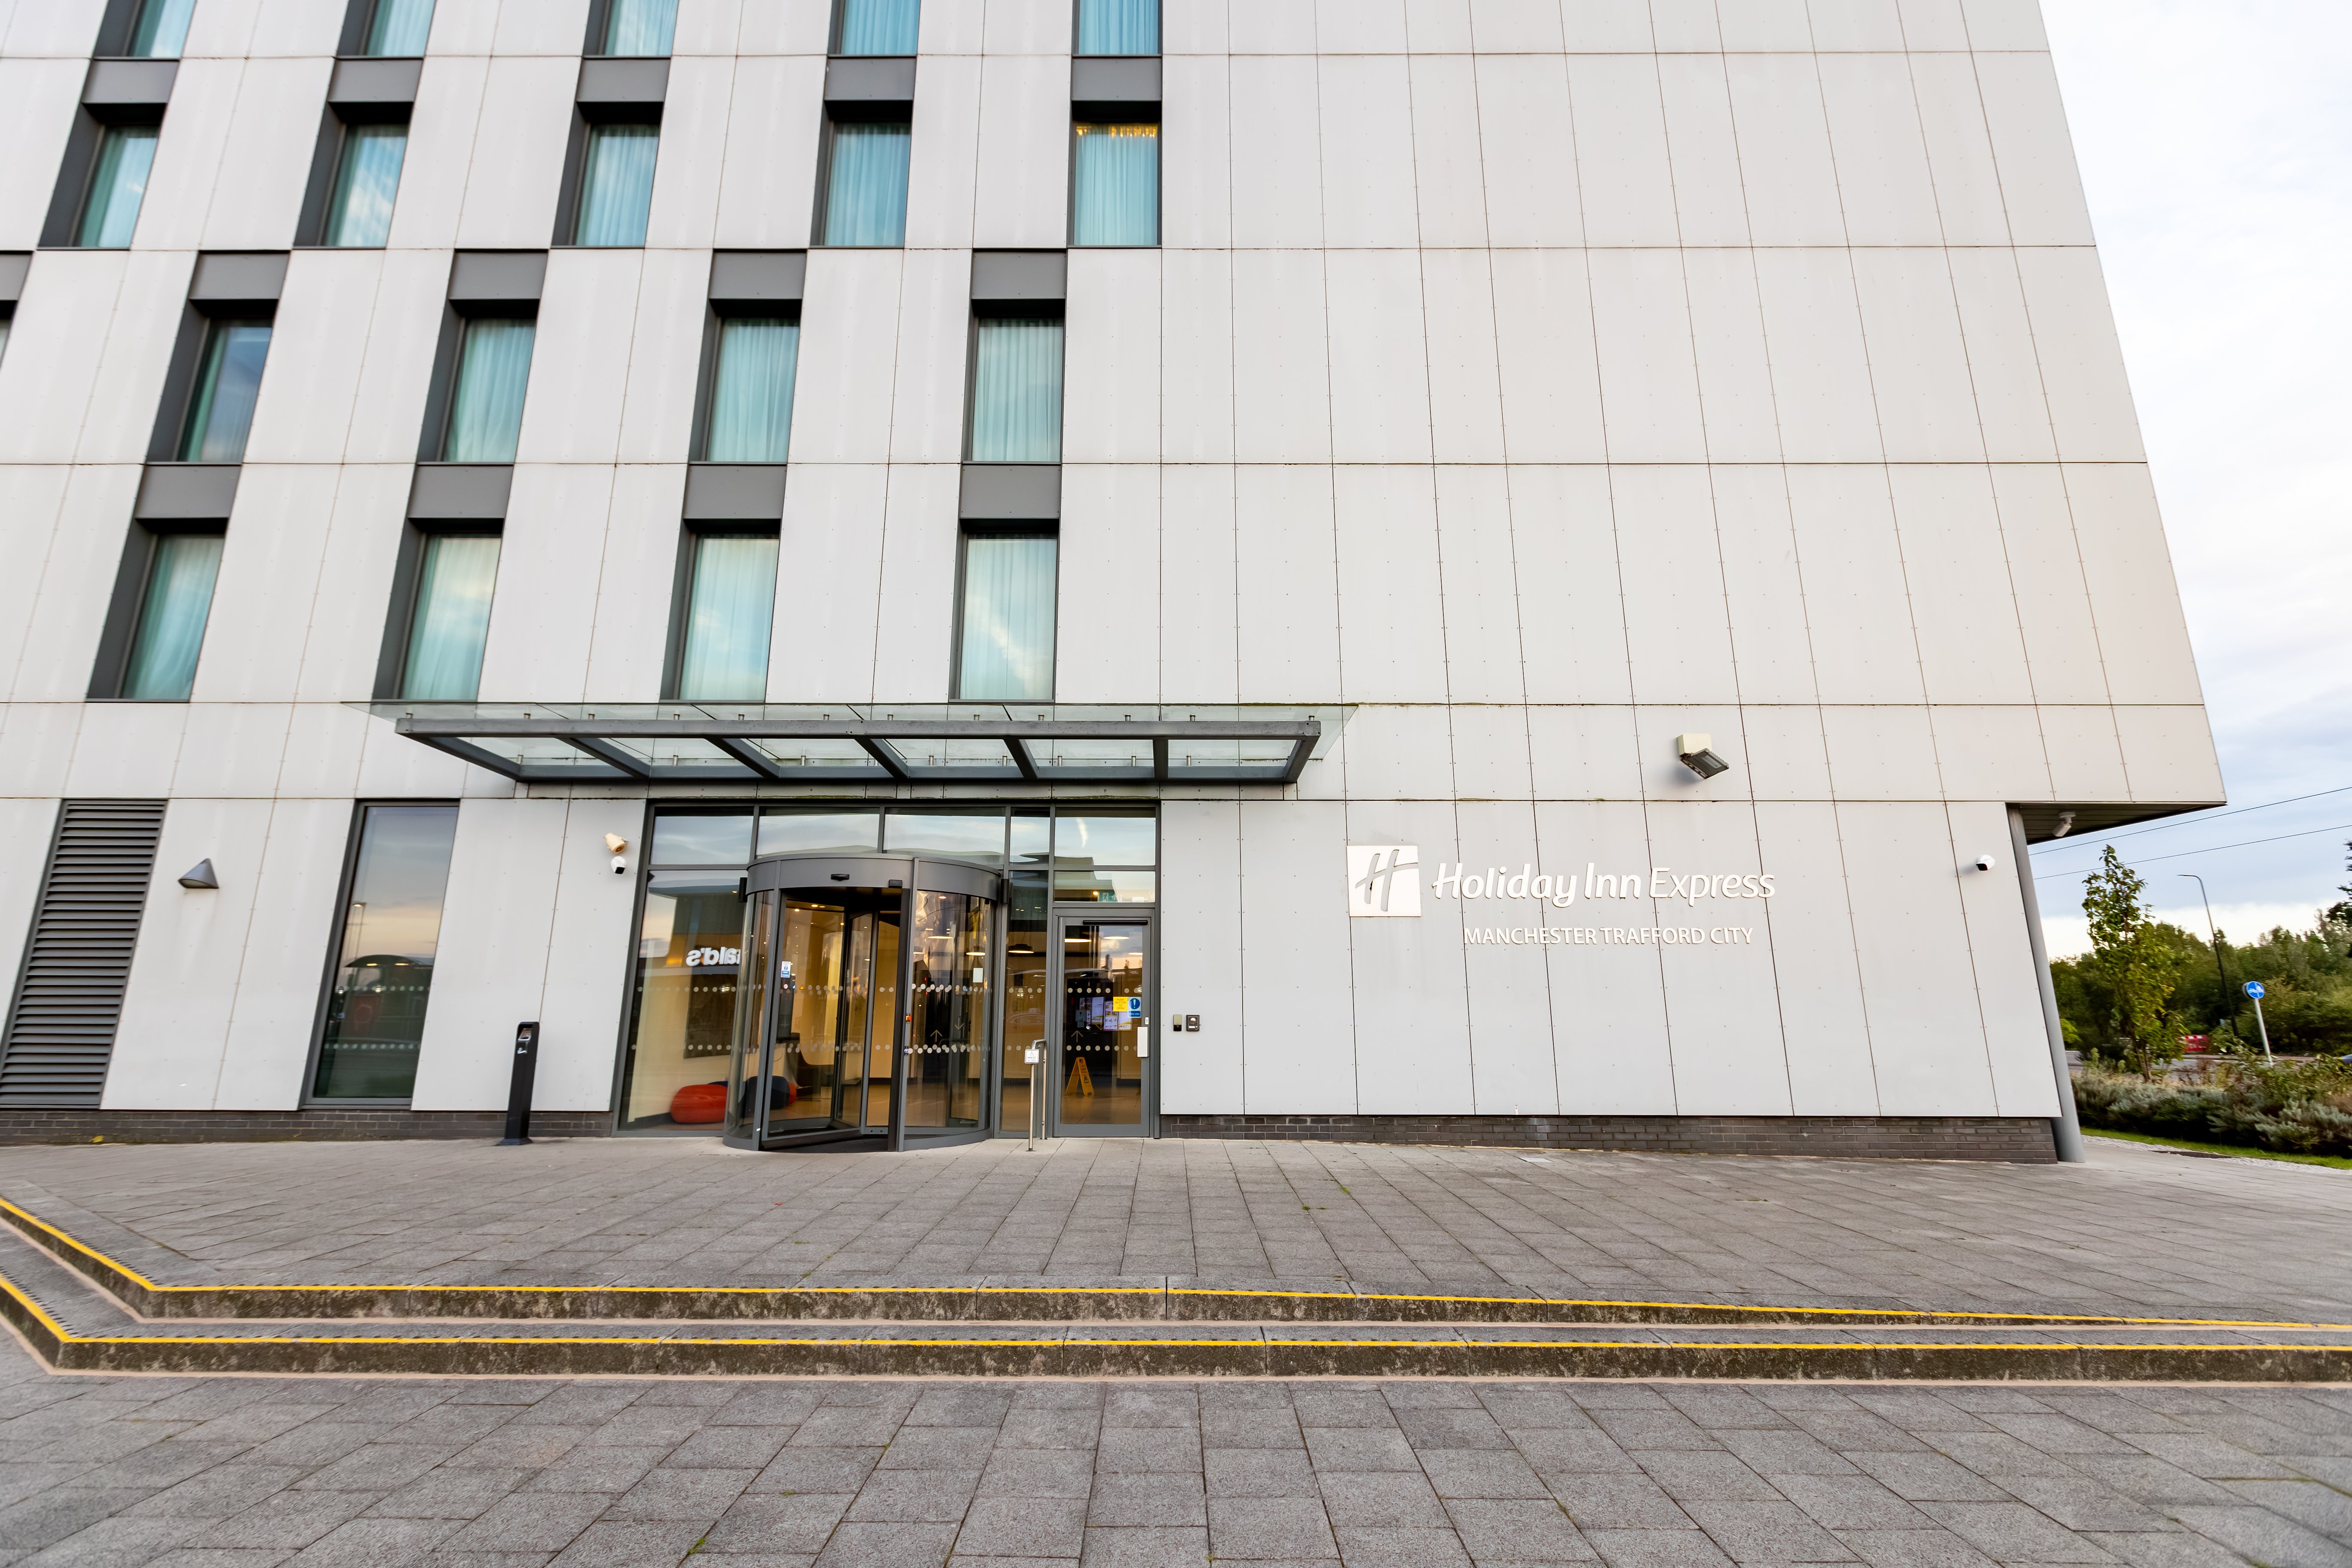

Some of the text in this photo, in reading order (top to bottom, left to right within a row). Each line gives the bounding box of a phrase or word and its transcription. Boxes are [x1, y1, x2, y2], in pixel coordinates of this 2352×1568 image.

[1432, 862, 1776, 908] Holiday Inn Express
[1464, 927, 1754, 945] MANCHESTER TRAFFORD CITY
